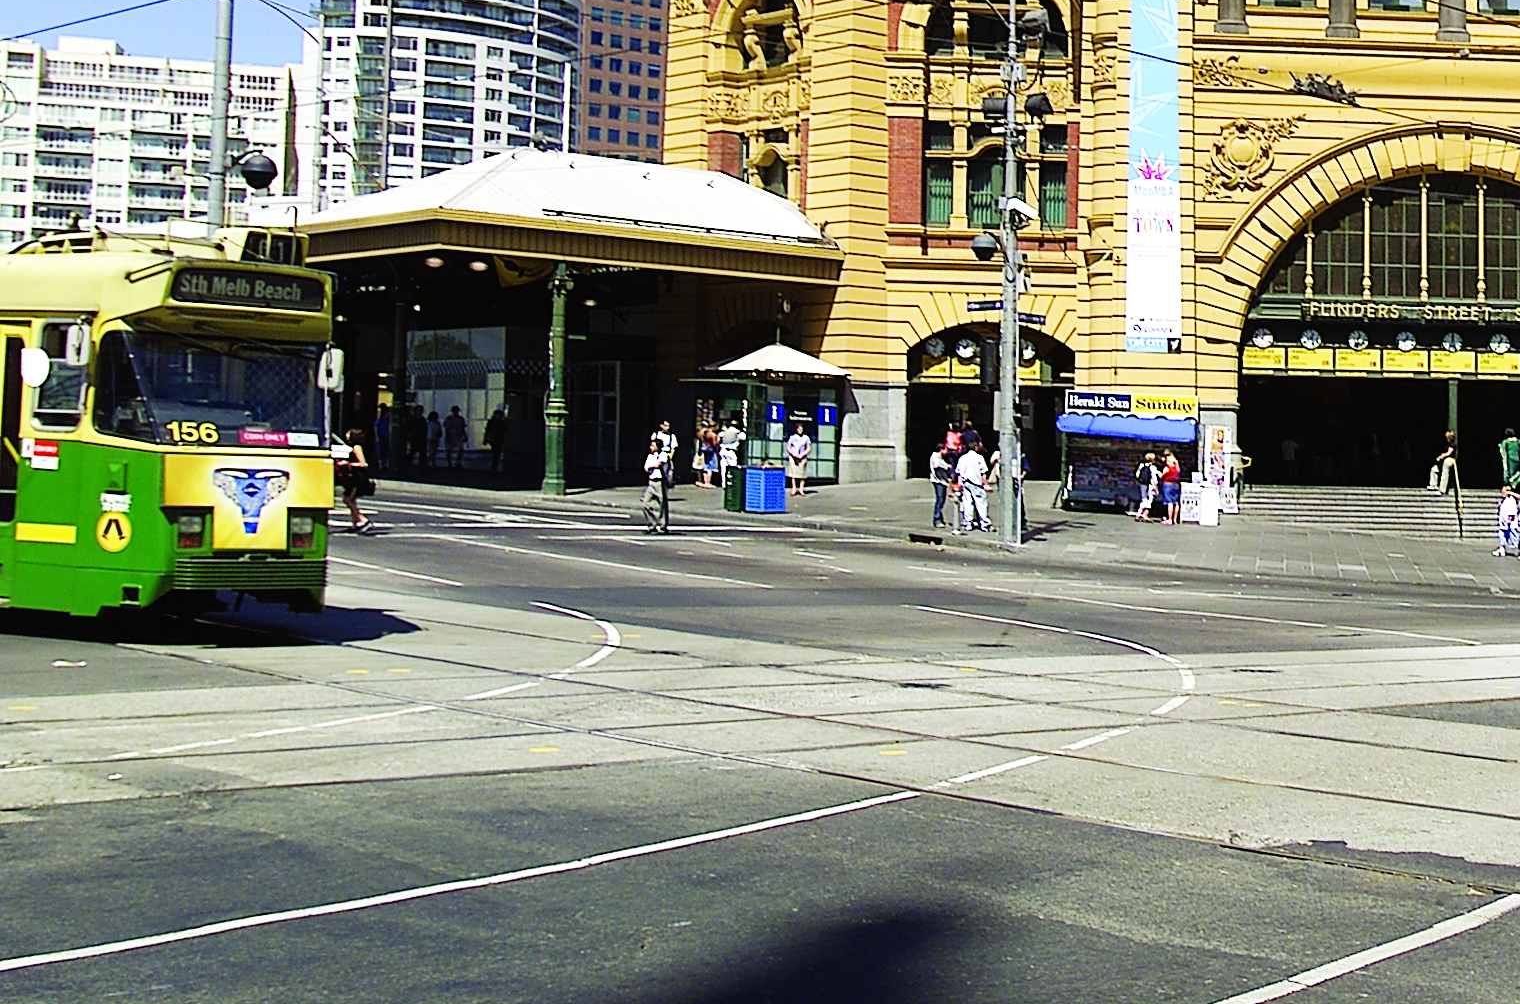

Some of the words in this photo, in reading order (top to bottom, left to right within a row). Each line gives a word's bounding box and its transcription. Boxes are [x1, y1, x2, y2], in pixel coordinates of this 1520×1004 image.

[1132, 217, 1174, 233] TOWN
[180, 274, 208, 294] Sth
[212, 276, 250, 297] Melb
[254, 280, 302, 301] Beach
[1309, 301, 1400, 319] FLINDERS
[1423, 305, 1491, 322] STREET
[1069, 394, 1105, 408] Herald
[1107, 396, 1130, 409] Sun
[1135, 397, 1195, 414] Sunday
[166, 420, 219, 443] 156
